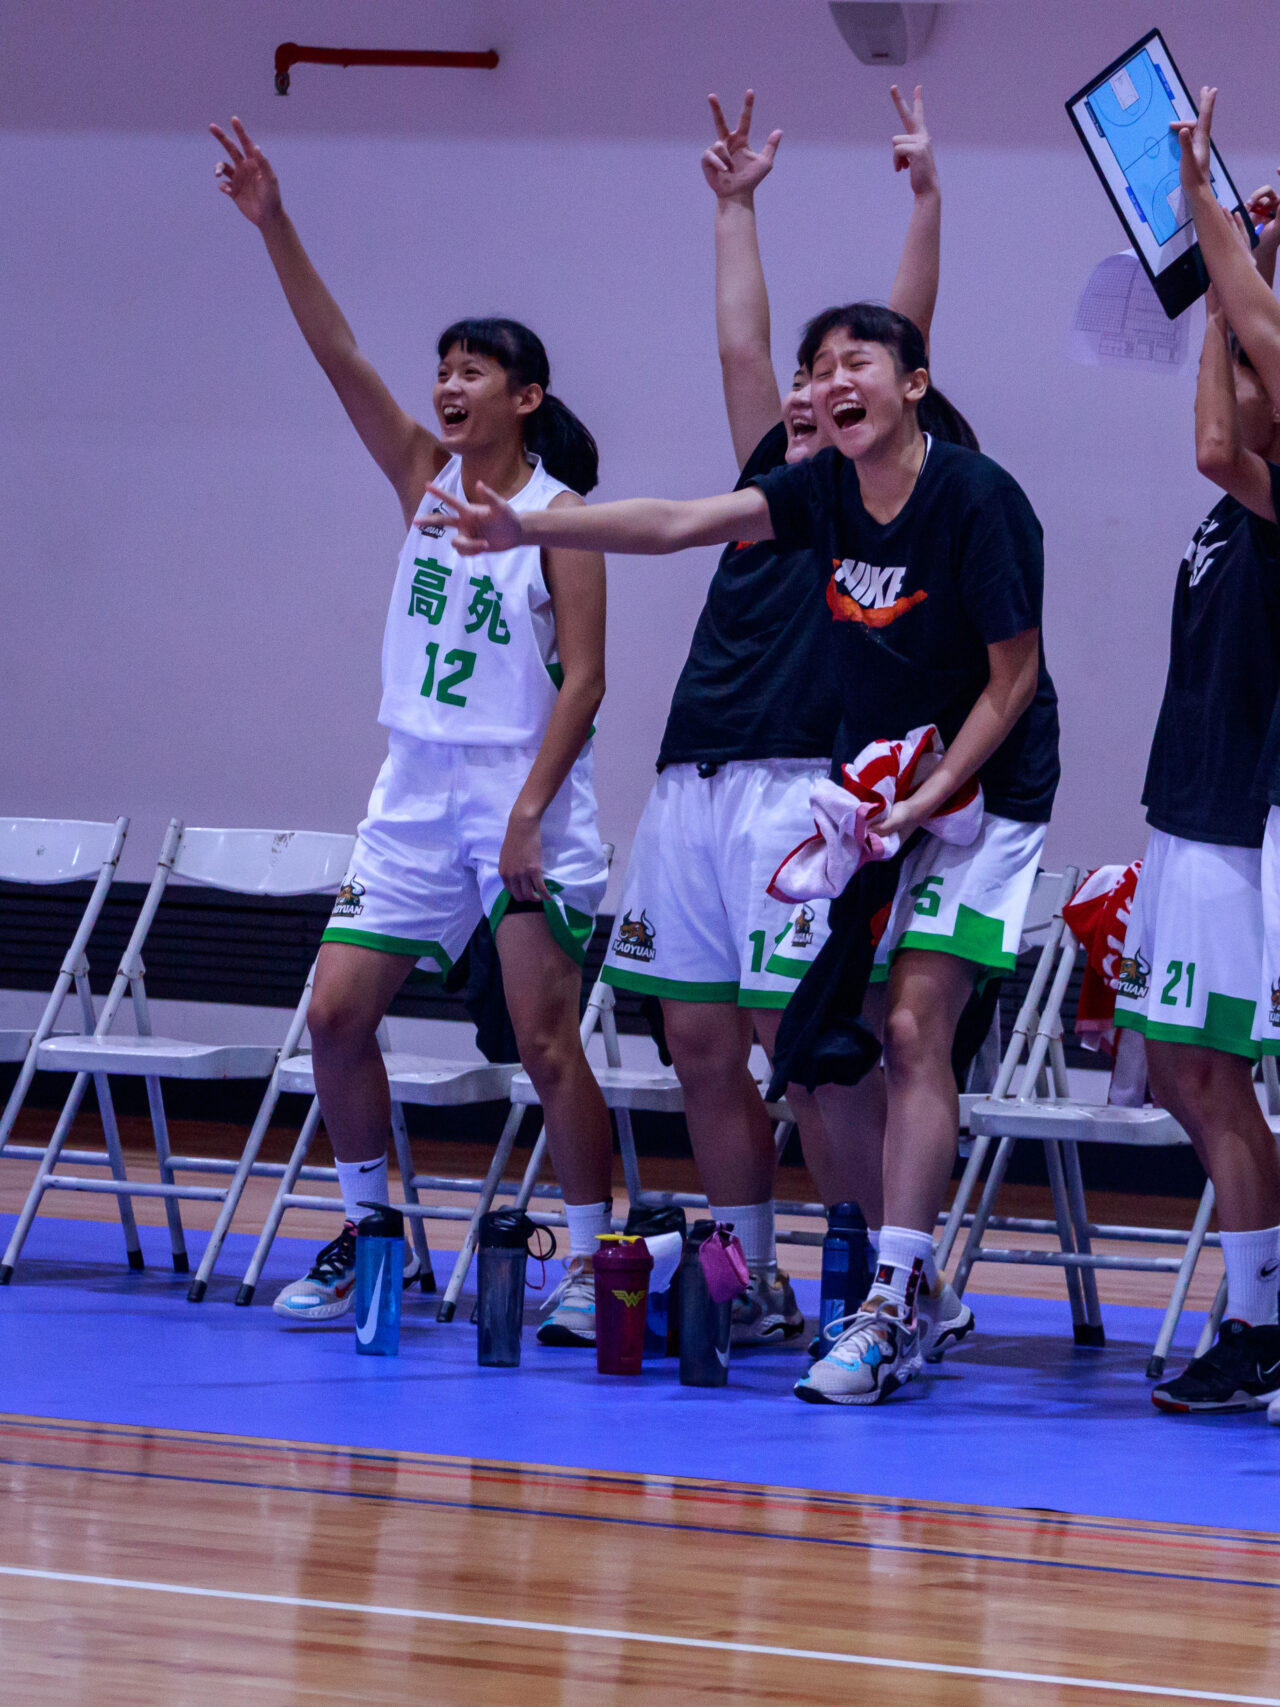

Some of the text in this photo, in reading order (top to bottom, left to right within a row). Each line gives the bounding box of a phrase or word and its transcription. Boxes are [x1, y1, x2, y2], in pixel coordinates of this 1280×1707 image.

[407, 557, 511, 646] 高苑
[834, 558, 907, 609] NIKE
[420, 641, 477, 708] 12
[612, 939, 657, 960] KAOYUAN
[1160, 960, 1196, 1008] 21
